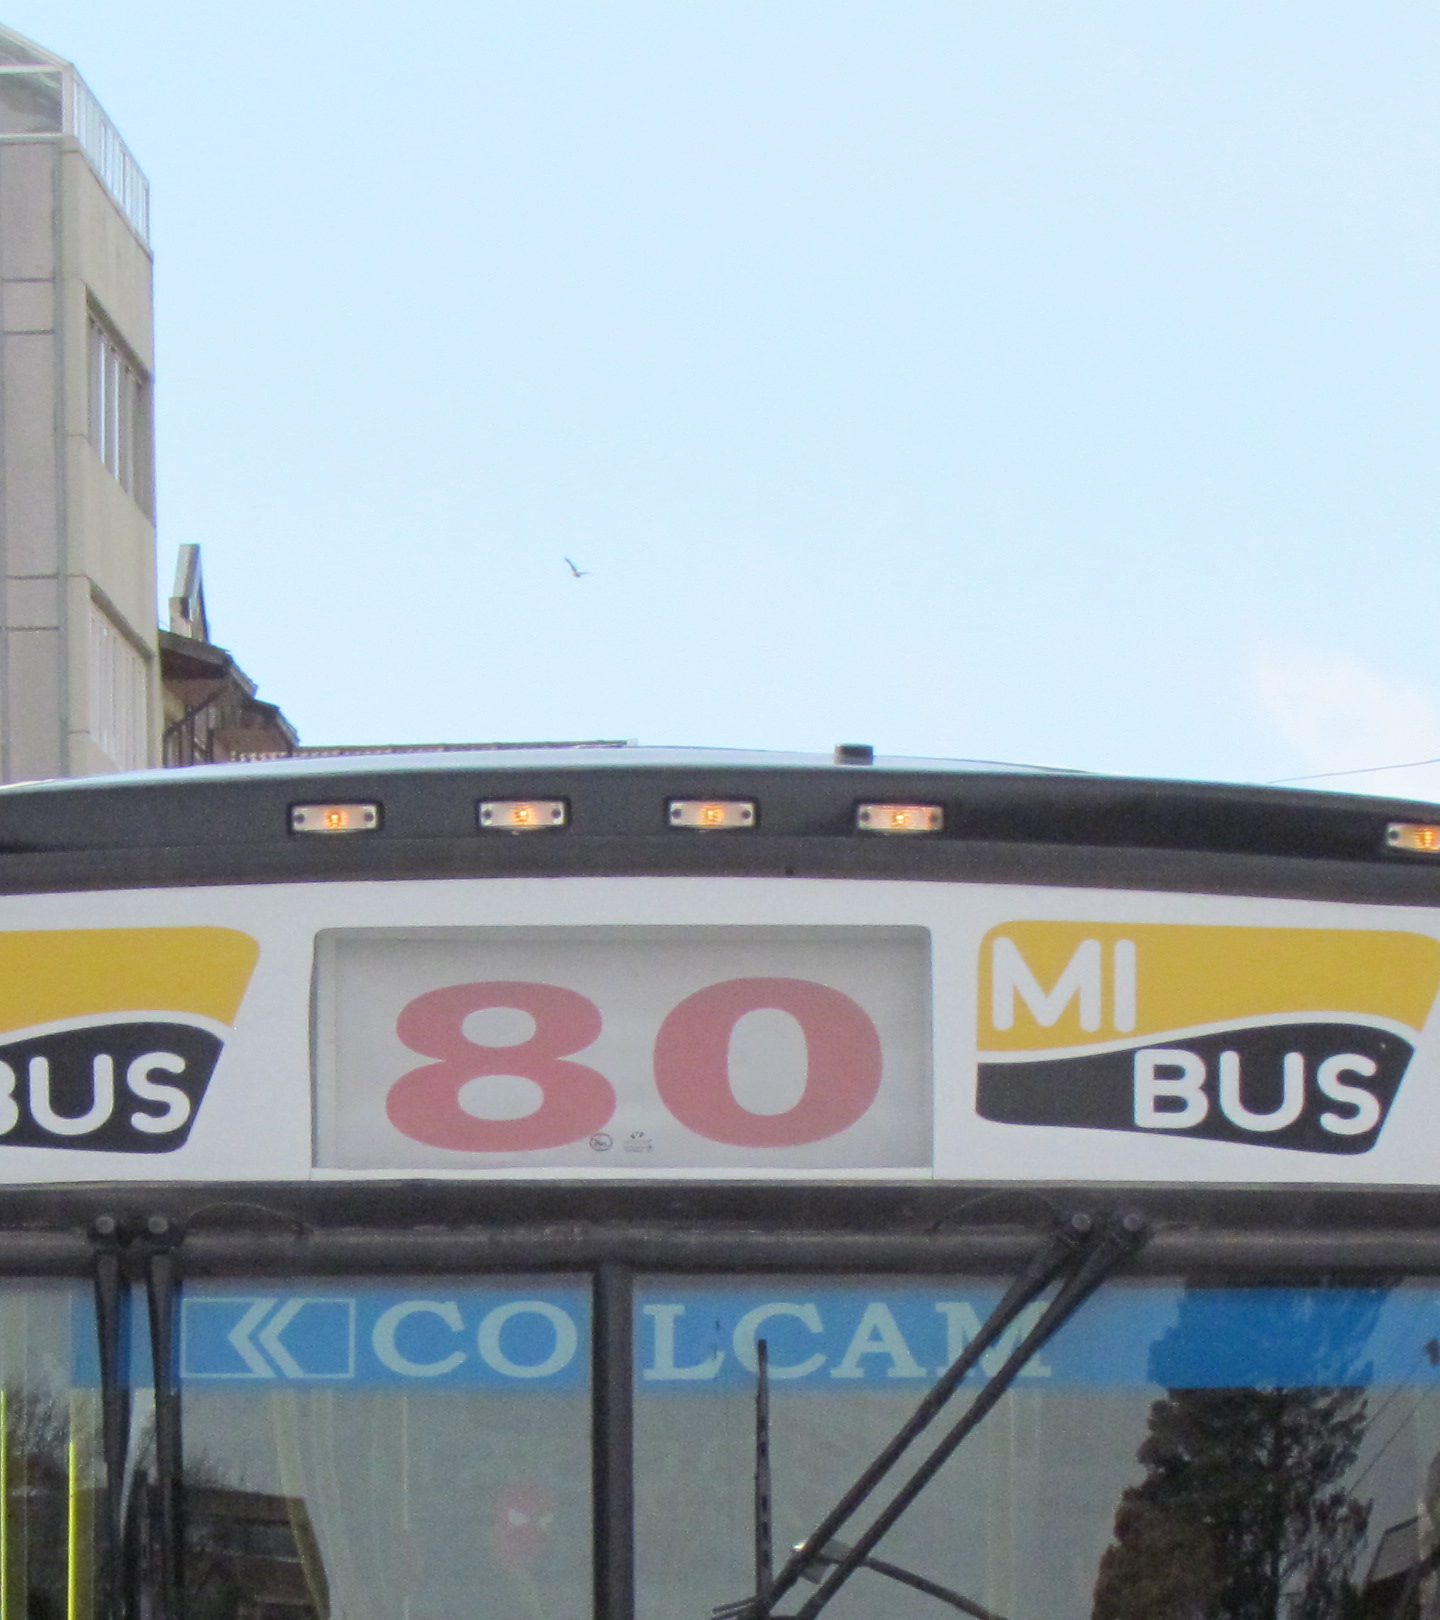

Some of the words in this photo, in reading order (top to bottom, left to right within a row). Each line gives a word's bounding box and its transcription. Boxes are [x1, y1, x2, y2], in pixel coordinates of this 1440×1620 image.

[992, 936, 1136, 1033] MI
[386, 977, 883, 1152] 80
[1133, 1048, 1381, 1135] BUS
